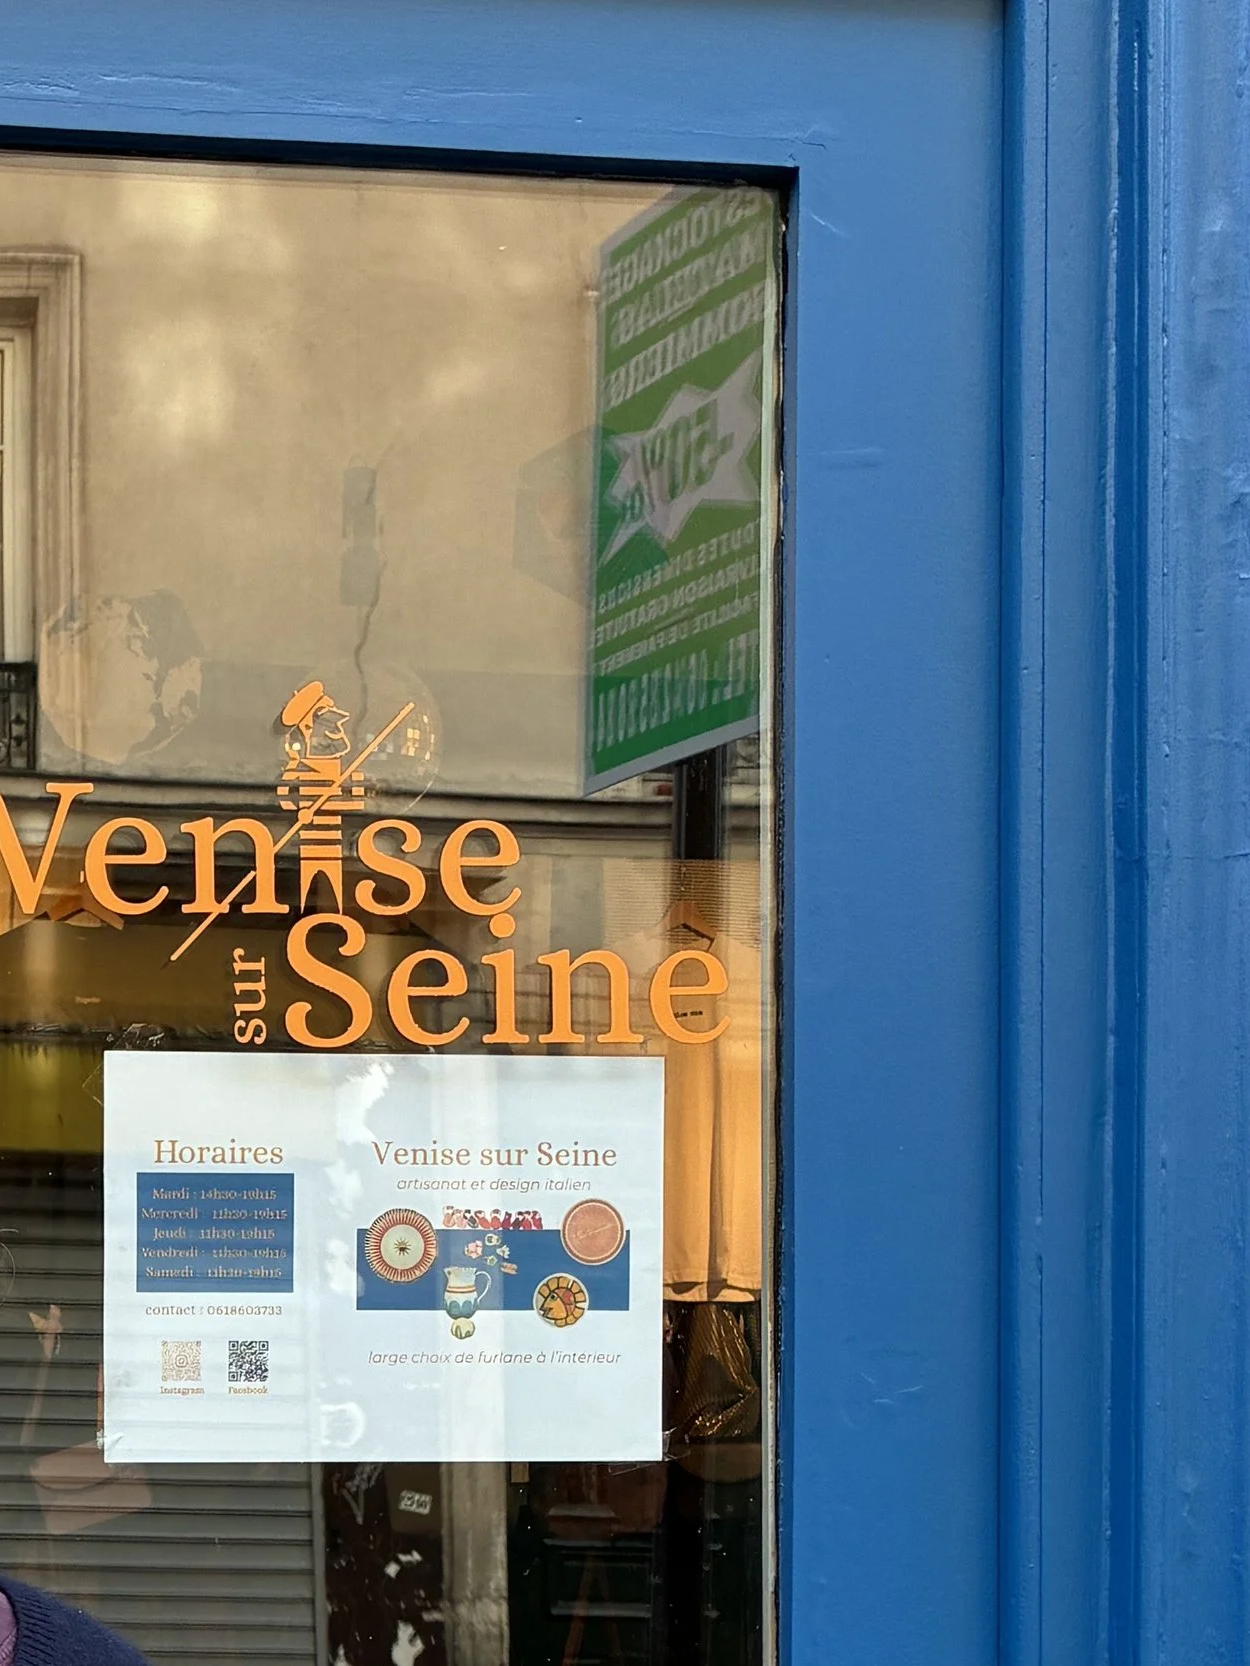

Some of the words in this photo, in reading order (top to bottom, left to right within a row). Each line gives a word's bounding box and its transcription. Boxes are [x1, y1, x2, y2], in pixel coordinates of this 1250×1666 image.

[233, 948, 268, 1046] sur
[284, 912, 731, 1048] Seine
[153, 1138, 284, 1165] Horaires
[371, 1139, 471, 1166] Venise
[480, 1148, 528, 1166] sur
[537, 1139, 618, 1167] Seine
[396, 1178, 466, 1191] artisanat
[470, 1179, 486, 1191] et
[489, 1177, 540, 1193] design
[544, 1177, 591, 1191] italien
[152, 1187, 190, 1200] Mardi
[141, 1207, 199, 1220] Mercredi
[153, 1227, 186, 1241] Jeudi
[141, 1246, 198, 1259] Vendredi
[145, 1266, 193, 1278] Samedi
[145, 1305, 196, 1316] contact
[207, 1305, 283, 1316] 0618603733
[368, 1351, 408, 1366] large
[411, 1350, 450, 1364] choix
[454, 1350, 474, 1364] de
[477, 1351, 533, 1364] furlane
[536, 1351, 547, 1364] à
[550, 1350, 622, 1364] l'intérieur
[160, 1386, 205, 1396] Instagram
[228, 1385, 269, 1395] Facebook
